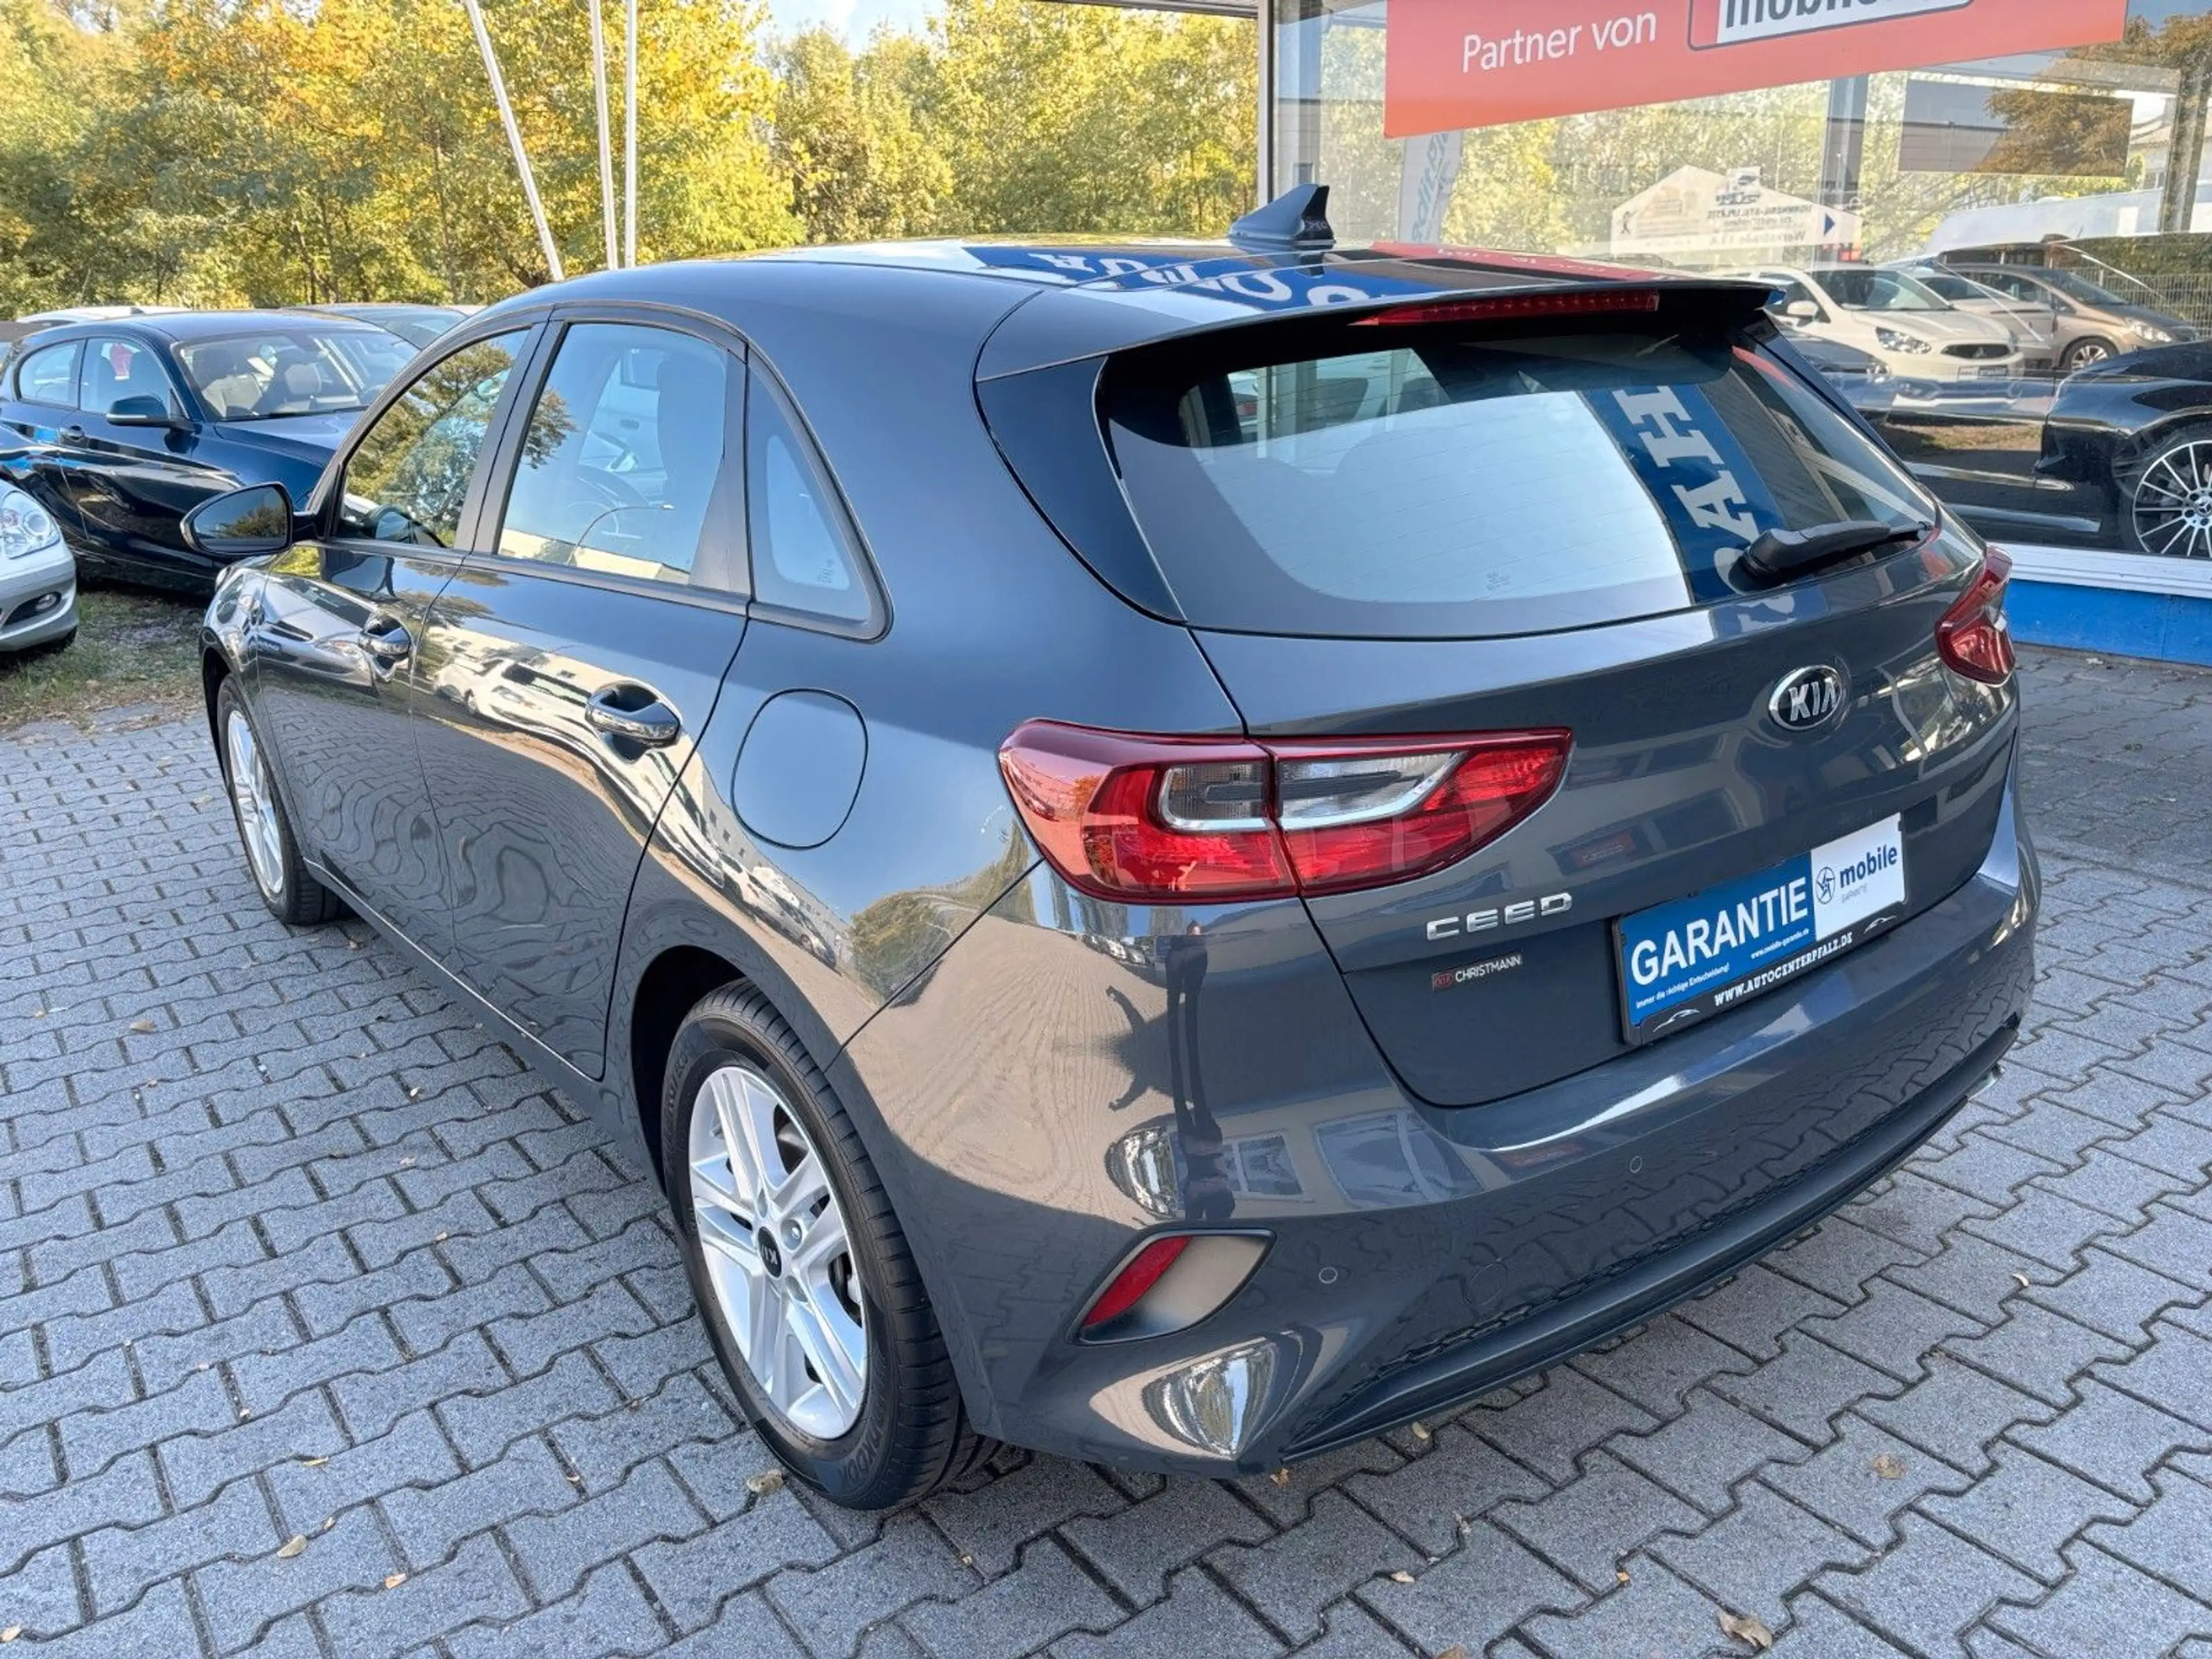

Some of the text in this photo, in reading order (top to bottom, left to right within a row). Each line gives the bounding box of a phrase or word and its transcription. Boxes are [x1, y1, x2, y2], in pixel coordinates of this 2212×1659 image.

[1463, 11, 1657, 73] Partner von
[1788, 677, 1837, 721] KIA
[1839, 844, 1897, 888] mobile
[1426, 892, 1573, 941] CEED
[1631, 876, 1808, 986] GARANTIE
[1455, 954, 1522, 983] CHRISTMANN
